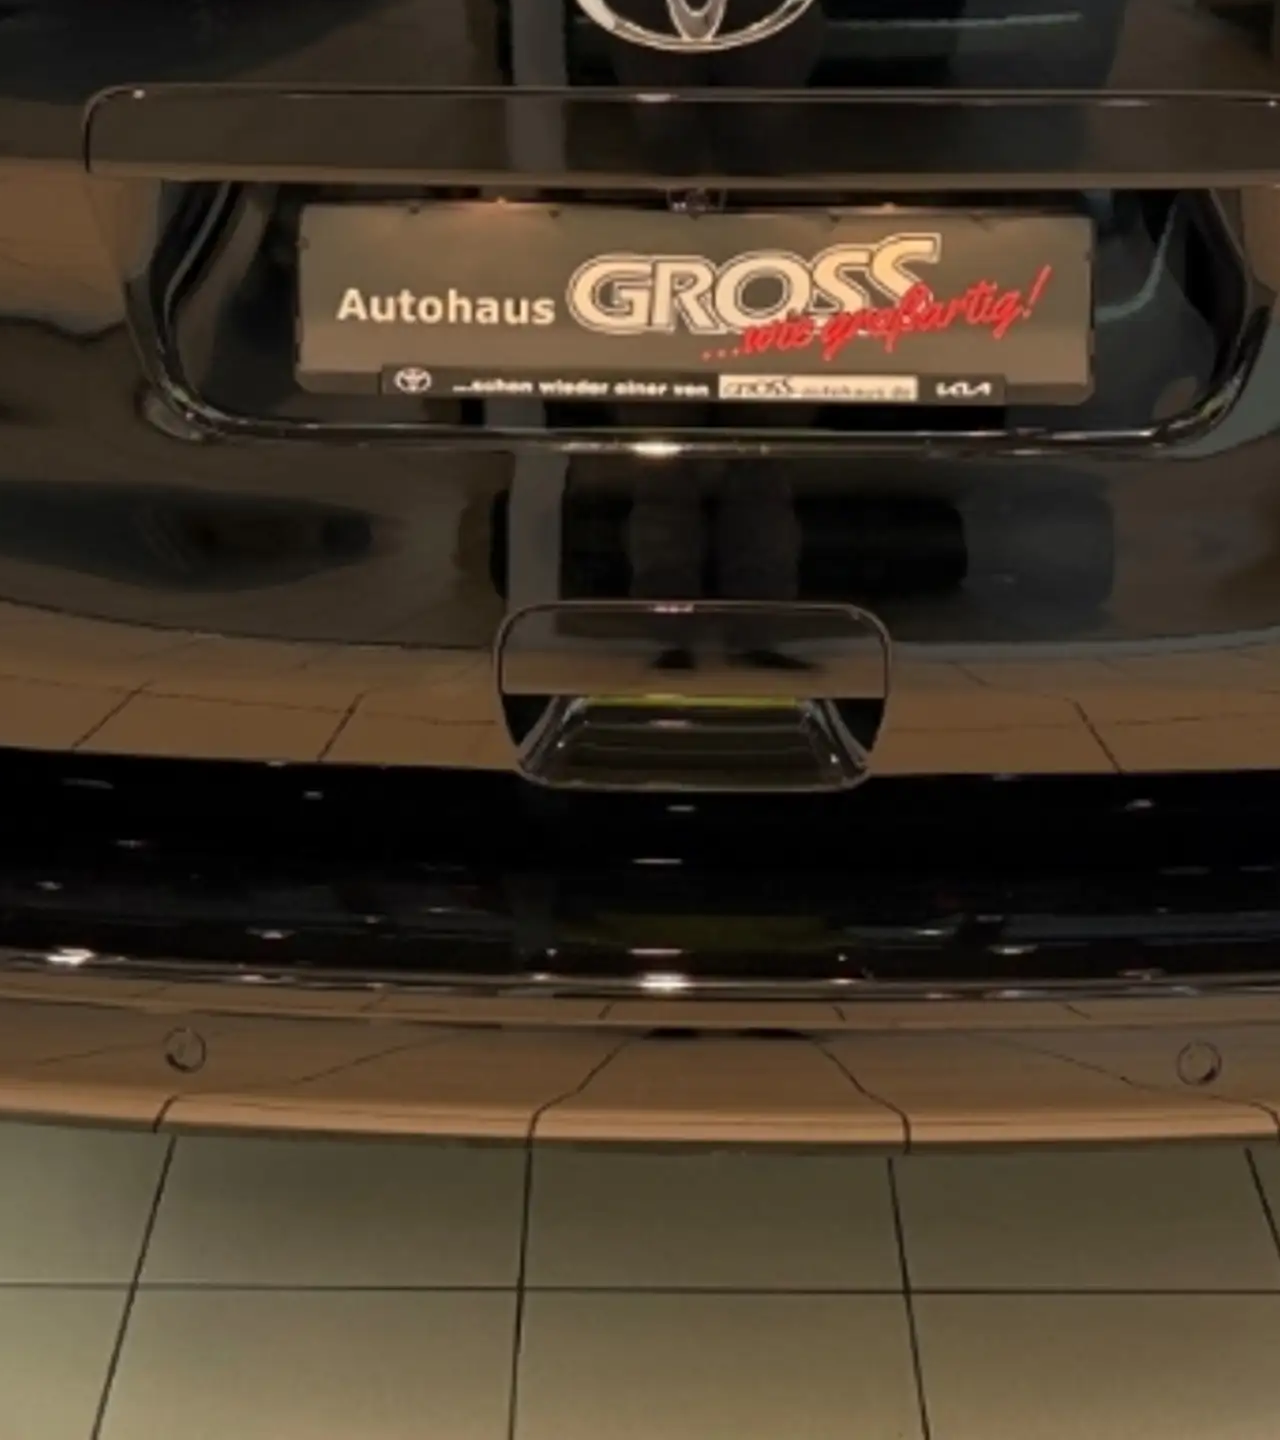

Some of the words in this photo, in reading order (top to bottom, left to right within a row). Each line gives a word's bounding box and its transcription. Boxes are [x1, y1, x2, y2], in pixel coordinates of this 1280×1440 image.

[336, 287, 556, 325] Autohaus
[564, 231, 942, 336] GROSS
[538, 377, 608, 395] wieder
[613, 379, 668, 397] einer
[672, 382, 710, 397] von
